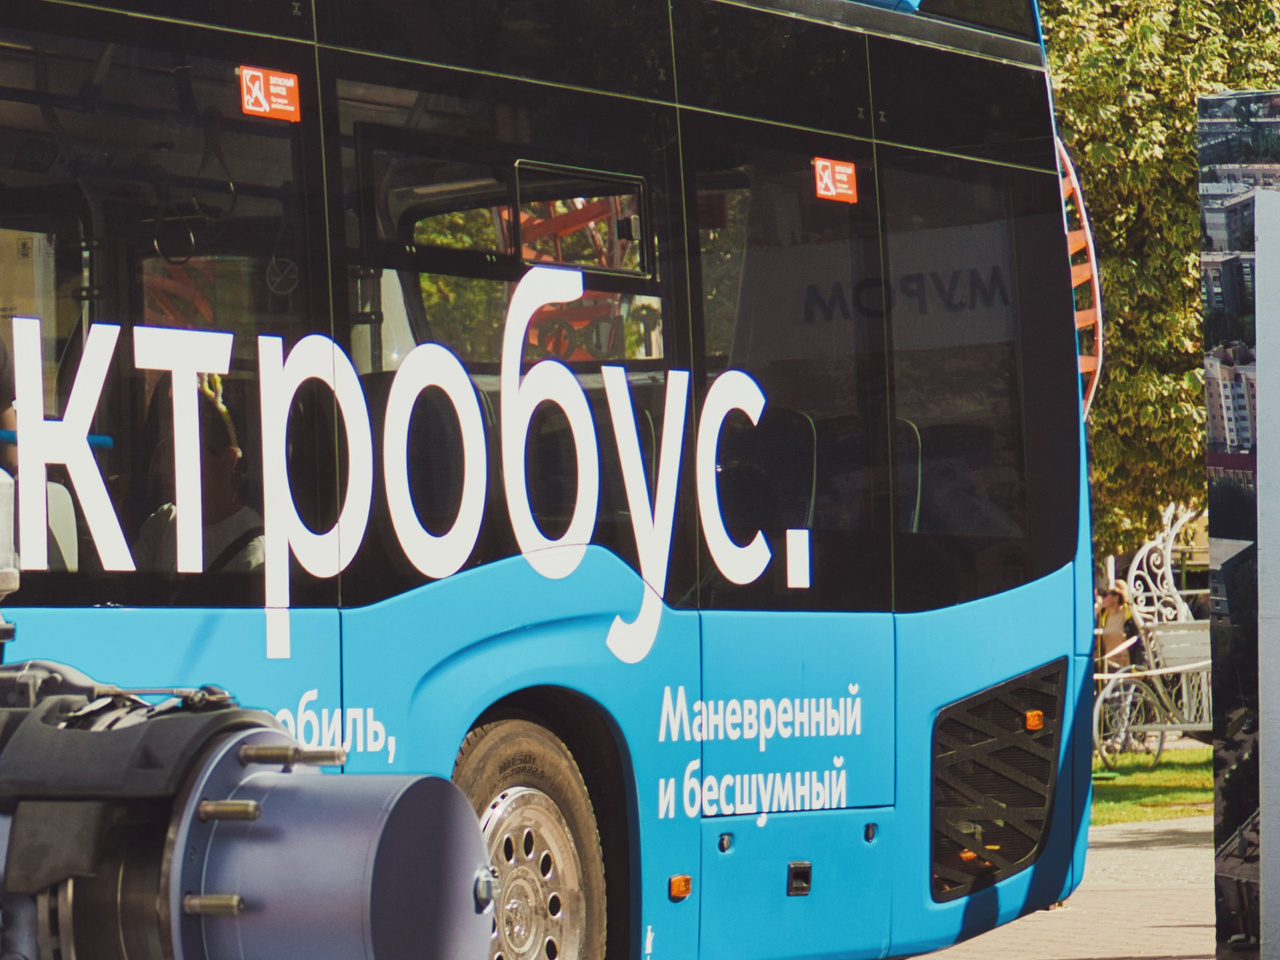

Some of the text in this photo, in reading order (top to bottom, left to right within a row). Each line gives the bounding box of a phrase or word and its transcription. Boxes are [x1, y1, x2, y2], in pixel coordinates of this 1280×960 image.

[658, 682, 862, 753] Маневренный
[658, 755, 847, 828] и бесшумный
